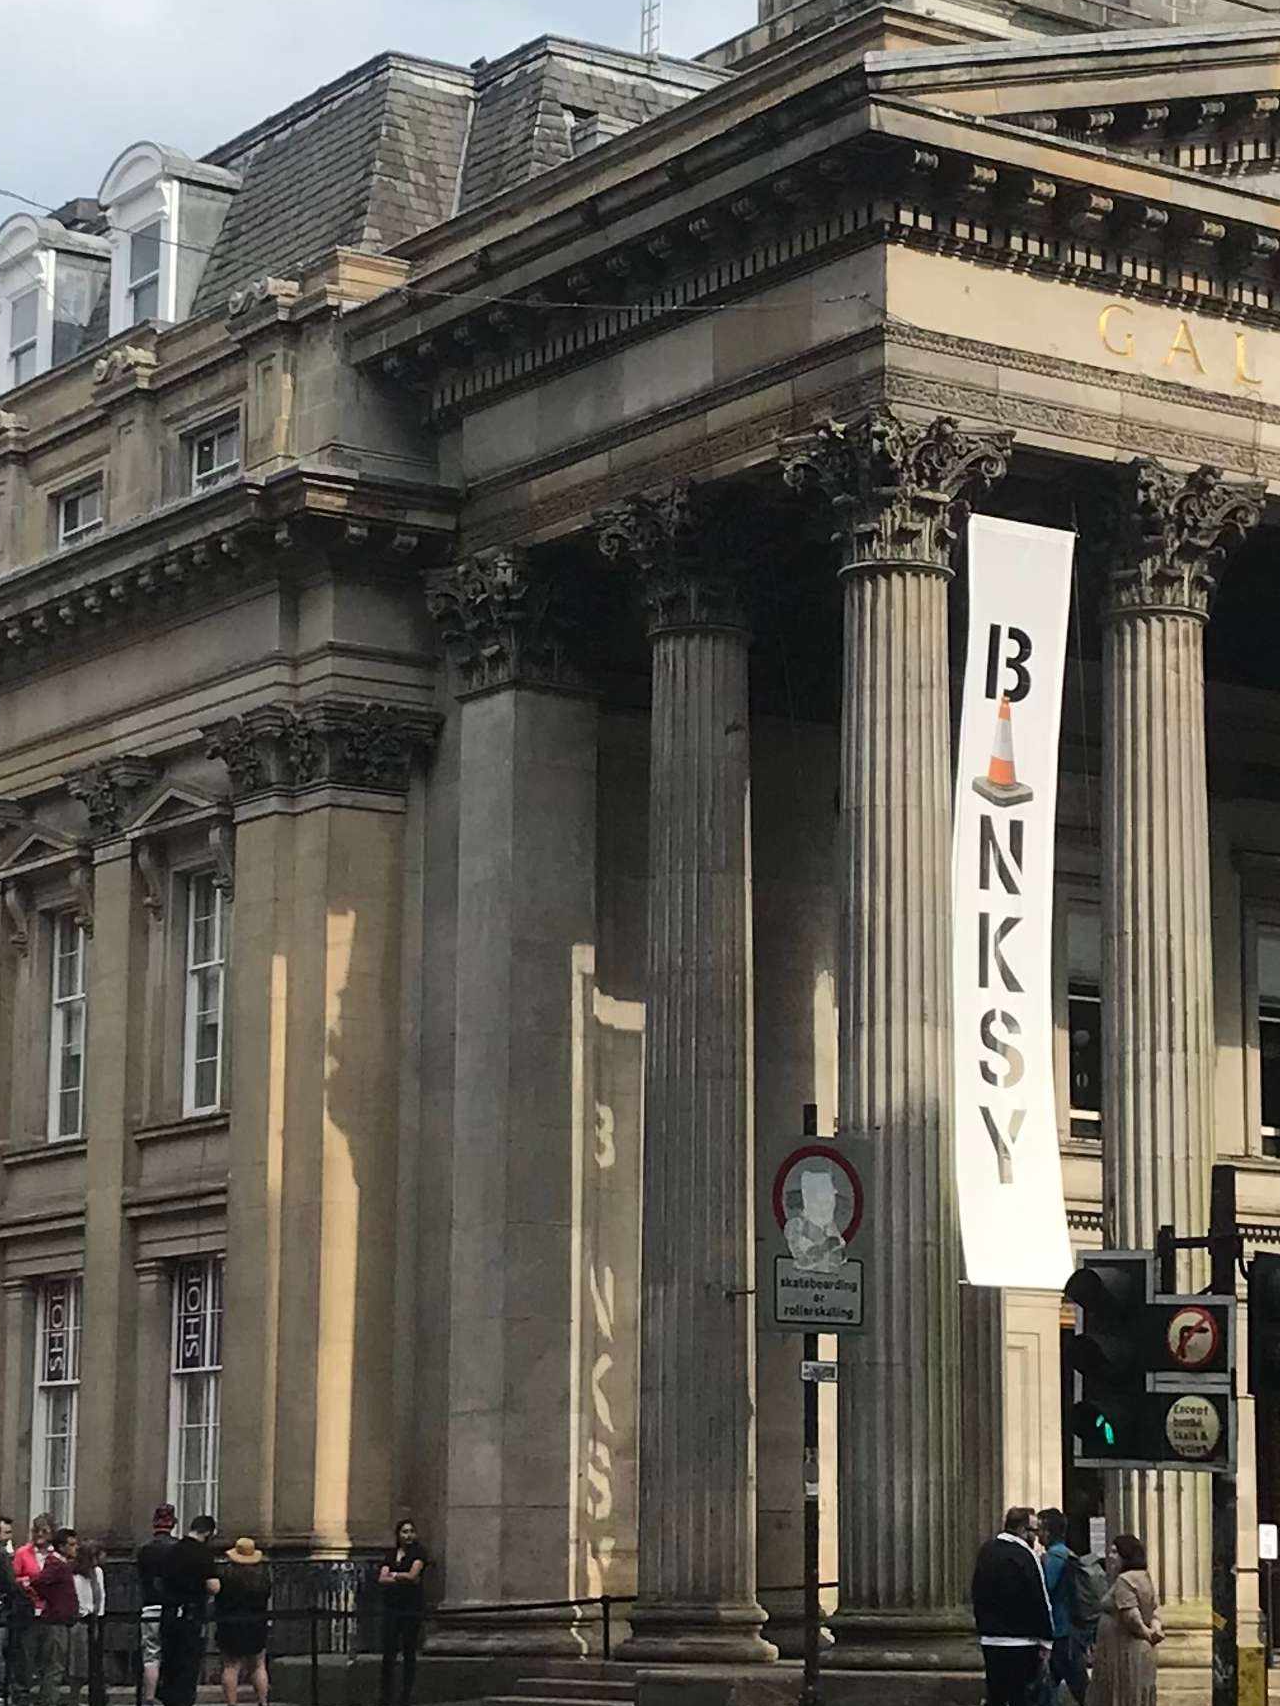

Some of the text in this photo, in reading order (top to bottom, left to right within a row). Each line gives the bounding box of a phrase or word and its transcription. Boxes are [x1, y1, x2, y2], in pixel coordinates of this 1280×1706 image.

[780, 1276, 858, 1293] skateboarding
[813, 1294, 825, 1303] or
[783, 1304, 854, 1320] rollerskating
